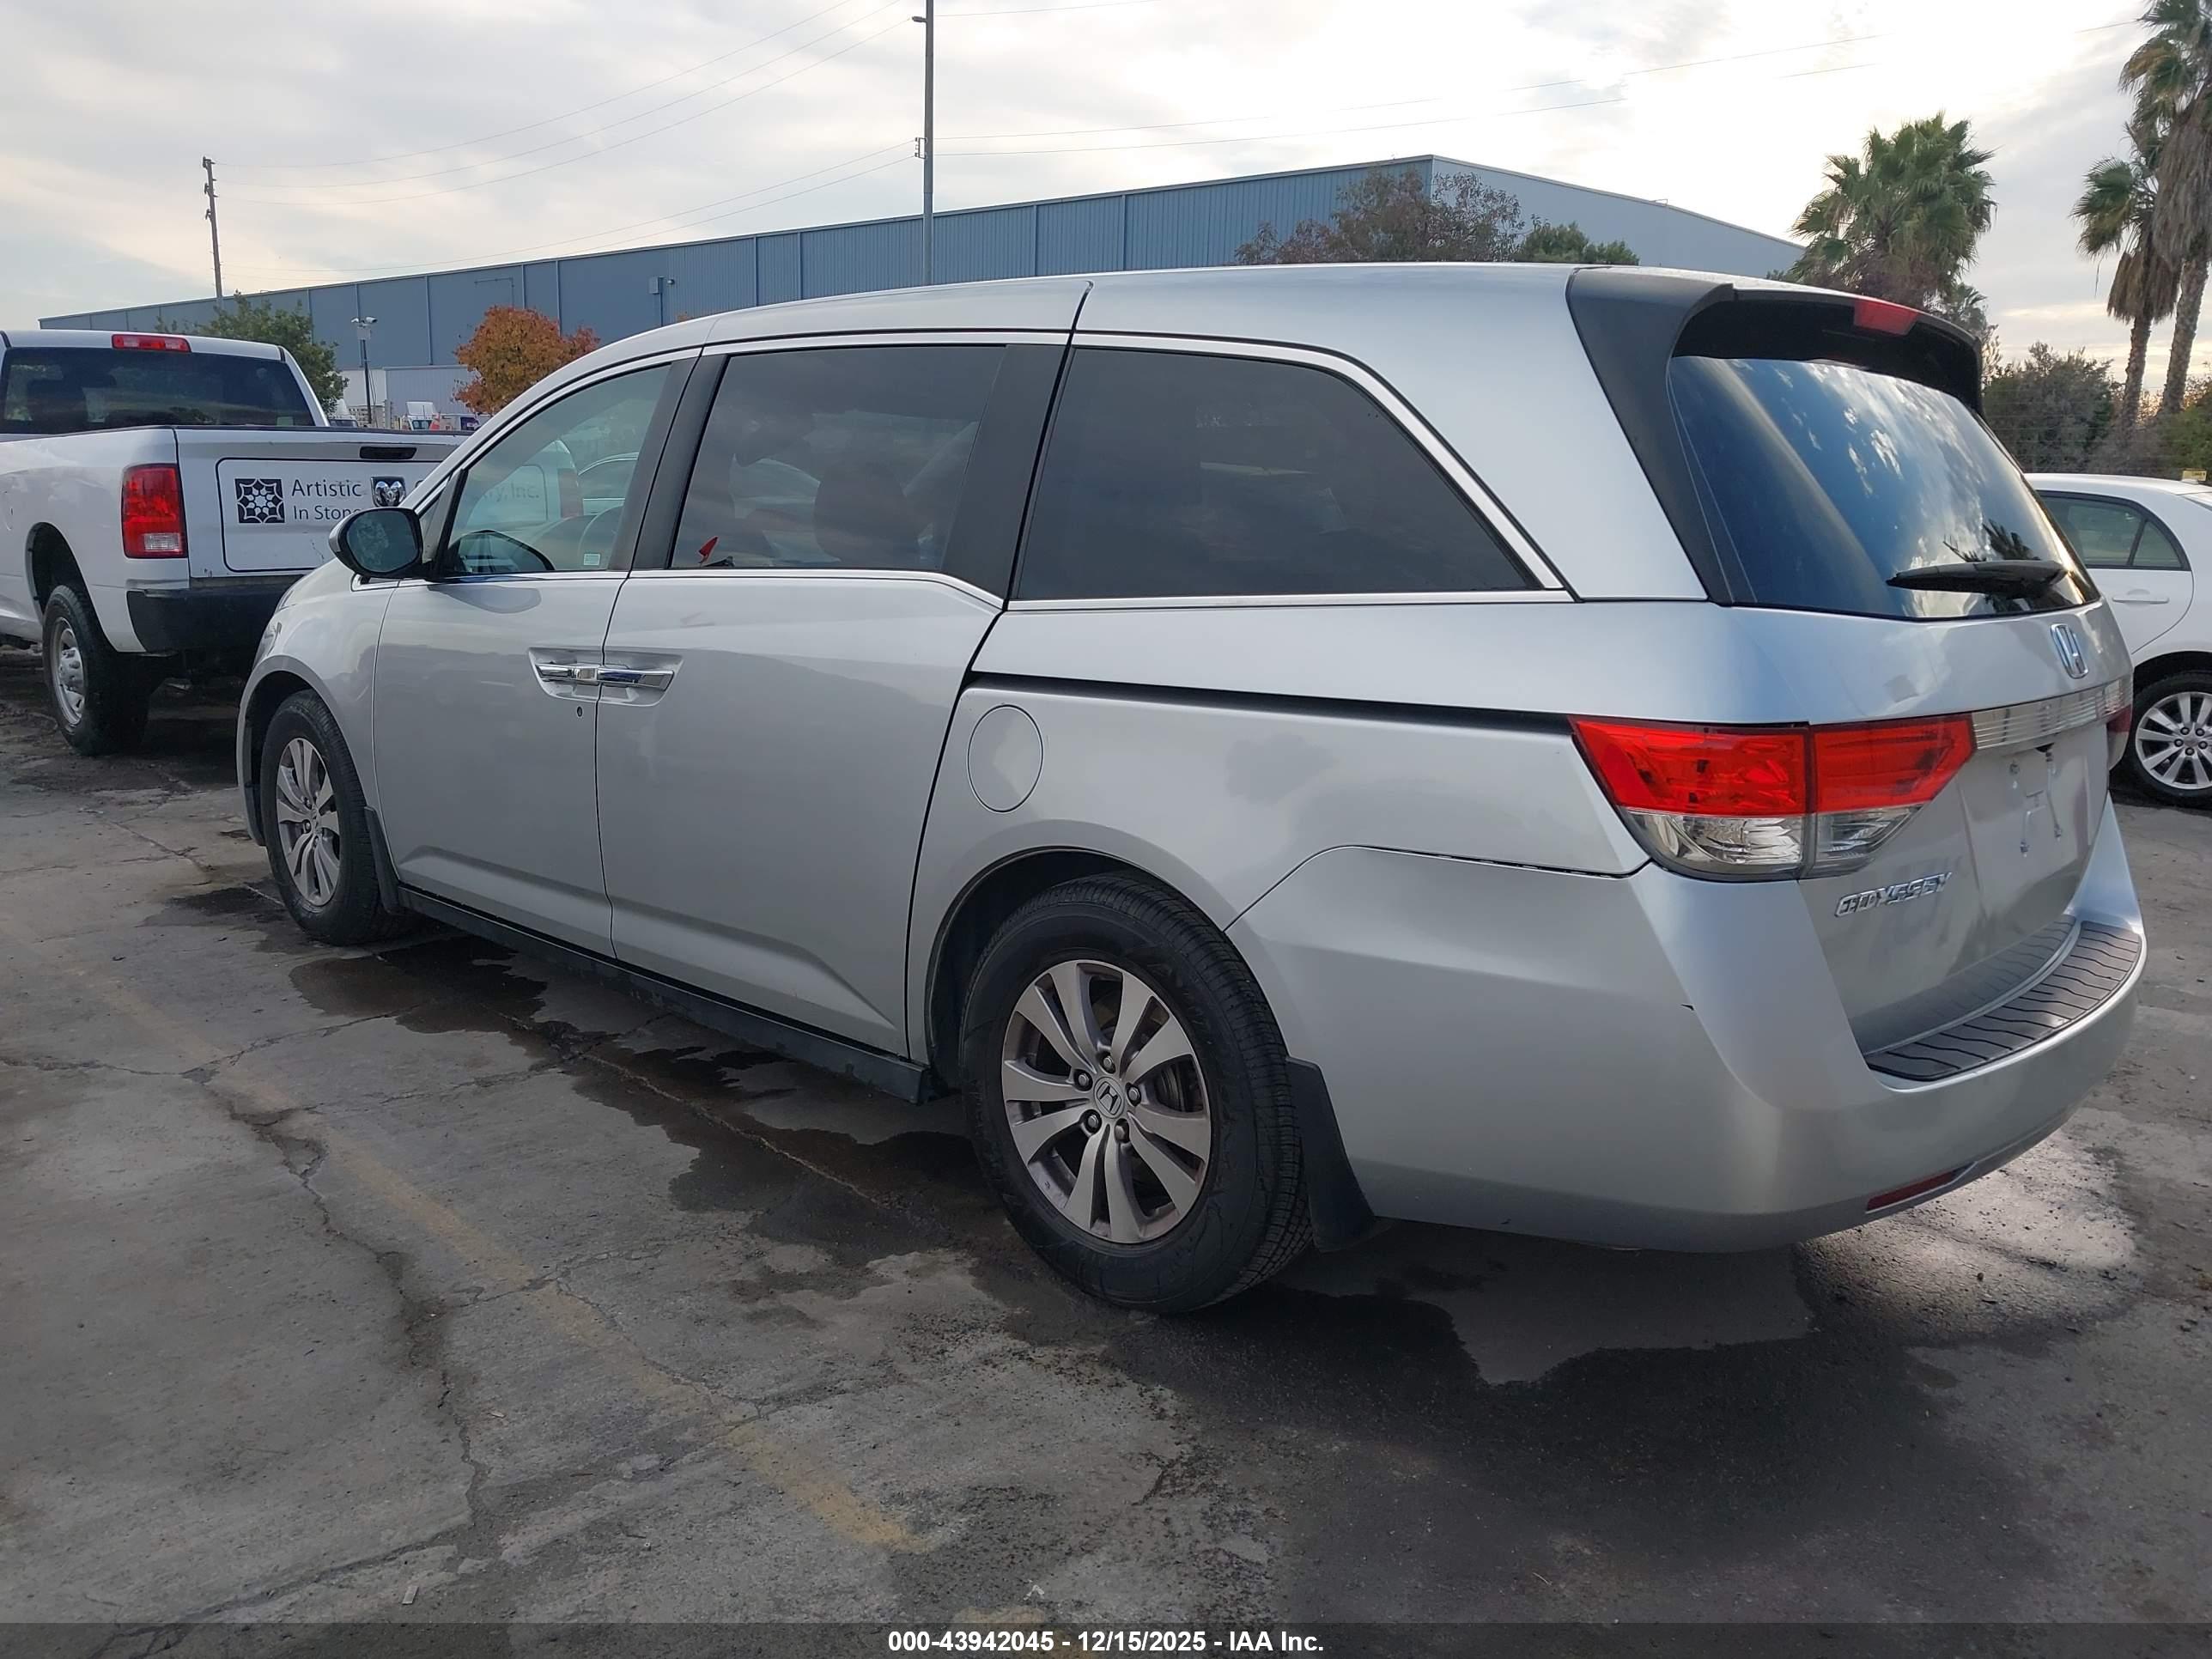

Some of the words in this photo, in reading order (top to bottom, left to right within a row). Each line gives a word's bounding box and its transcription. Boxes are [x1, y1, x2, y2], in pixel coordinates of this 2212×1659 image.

[291, 478, 362, 497] Artistic
[510, 482, 540, 500] Inc.
[293, 505, 309, 520] In
[1834, 872, 1954, 917] ODYSSEY
